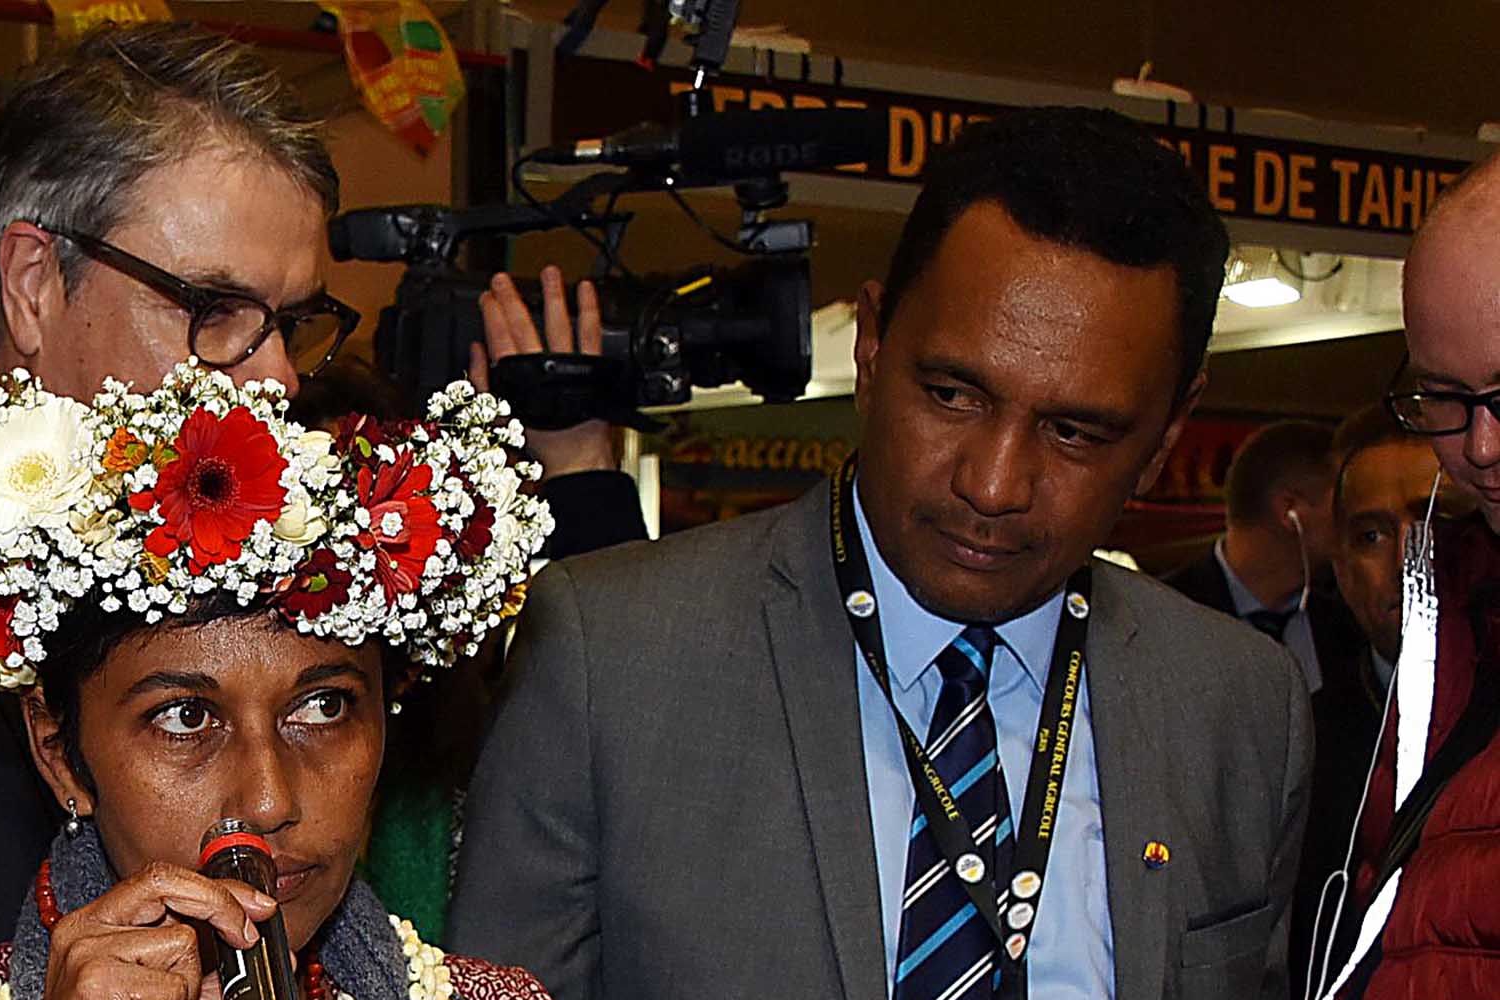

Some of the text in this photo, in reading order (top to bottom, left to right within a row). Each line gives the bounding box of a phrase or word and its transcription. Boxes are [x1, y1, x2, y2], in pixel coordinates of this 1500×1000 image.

[1253, 150, 1317, 220] DE
[1059, 650, 1081, 718] CONCOURS
[920, 759, 961, 823] AGRICOLE
[1037, 778, 1059, 839] AGRICOLE
